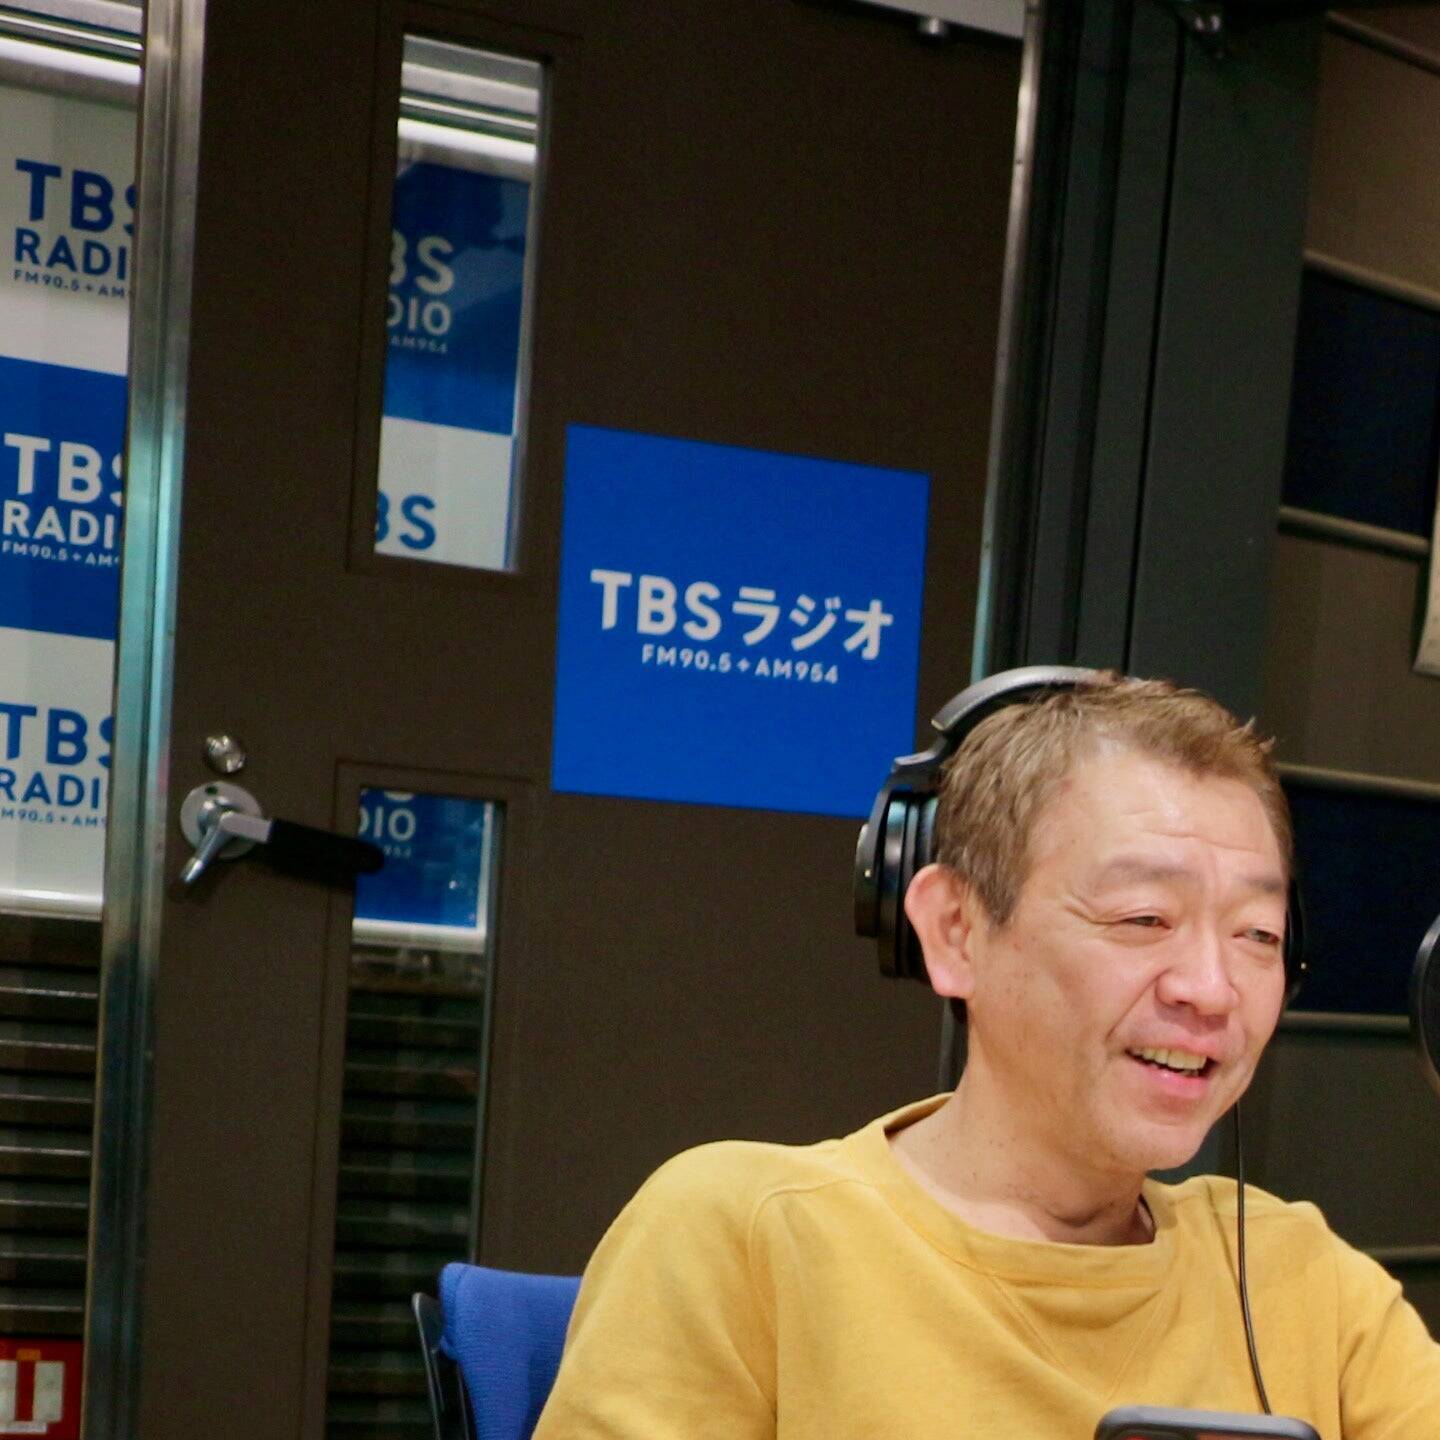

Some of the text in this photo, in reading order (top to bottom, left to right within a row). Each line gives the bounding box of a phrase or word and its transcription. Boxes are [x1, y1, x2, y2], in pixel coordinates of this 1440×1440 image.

[14, 227, 127, 282] RADI
[2, 499, 115, 551] RADI
[0, 766, 101, 811] RADI
